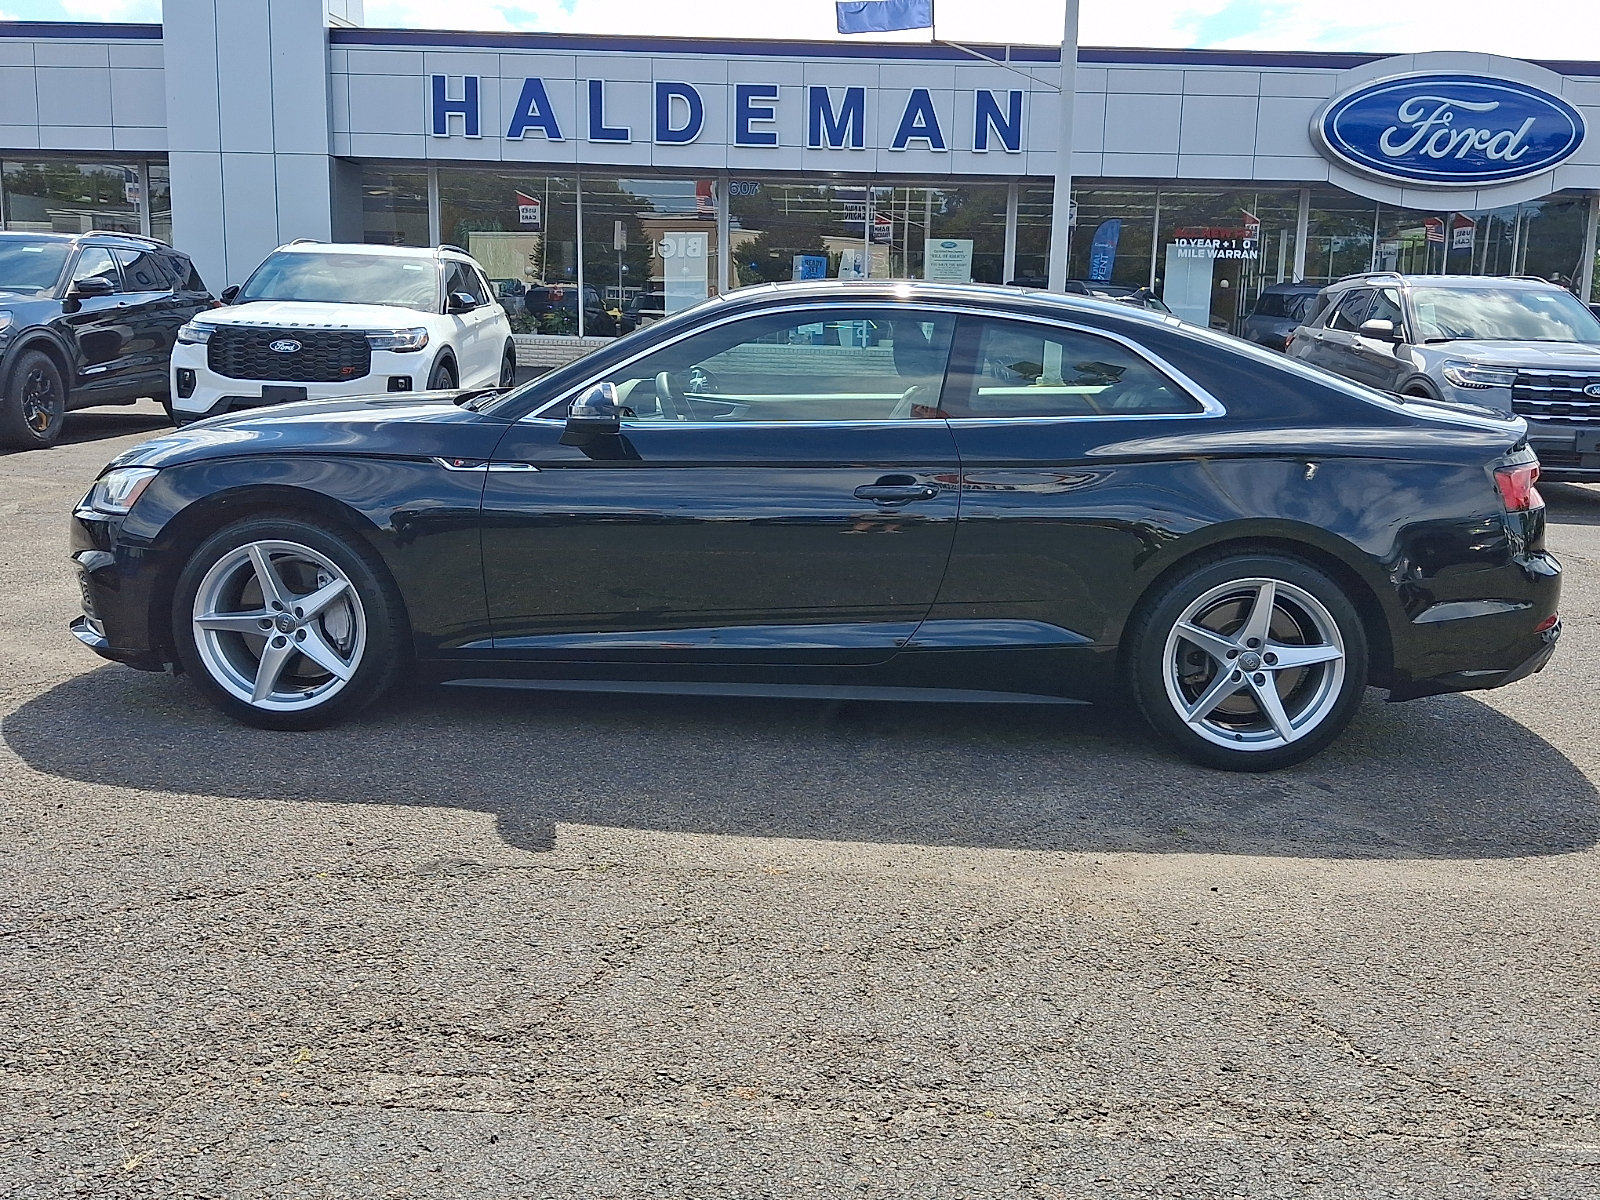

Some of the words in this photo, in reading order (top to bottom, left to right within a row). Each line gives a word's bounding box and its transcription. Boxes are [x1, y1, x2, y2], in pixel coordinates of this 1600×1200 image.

[431, 73, 1024, 153] HALDEMAN
[1379, 94, 1536, 162] Ford
[729, 181, 759, 195] 607
[1174, 239, 1187, 248] 10
[1189, 239, 1221, 249] YEAR
[1177, 249, 1205, 258] MILE
[1207, 249, 1258, 259] WARRAN
[1091, 253, 1101, 280] ROVAL
[1097, 253, 1109, 280] VENT
[274, 342, 295, 351] Ford
